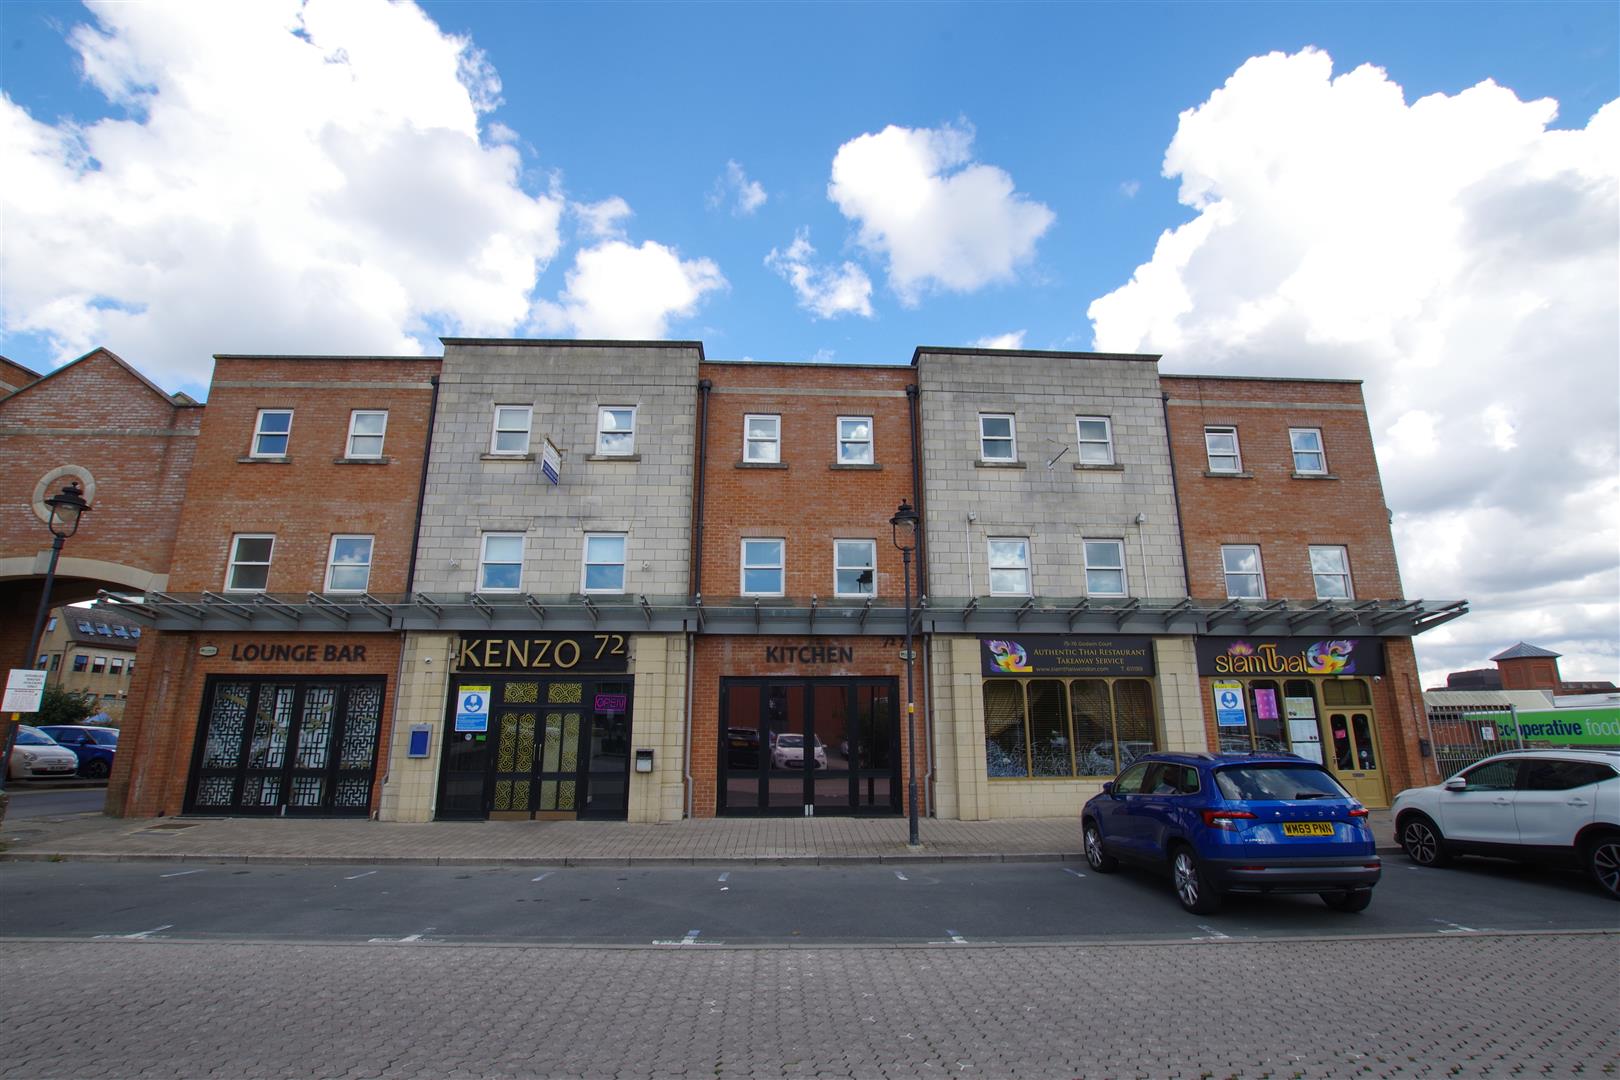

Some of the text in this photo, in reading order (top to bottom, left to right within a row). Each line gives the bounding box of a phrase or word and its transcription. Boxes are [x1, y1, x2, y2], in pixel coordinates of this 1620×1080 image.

[231, 644, 367, 662] LOUNGE BAR
[459, 634, 625, 668] KENZO 72
[766, 646, 853, 664] KITCHEN
[1033, 648, 1078, 656] AUTHENTIC
[1079, 648, 1097, 656] THAI
[1056, 657, 1125, 665] TAKEAWAY SERVICE
[597, 697, 624, 709] OPEN
[1585, 717, 1620, 737] food
[1284, 823, 1332, 834] WM69 PNN
